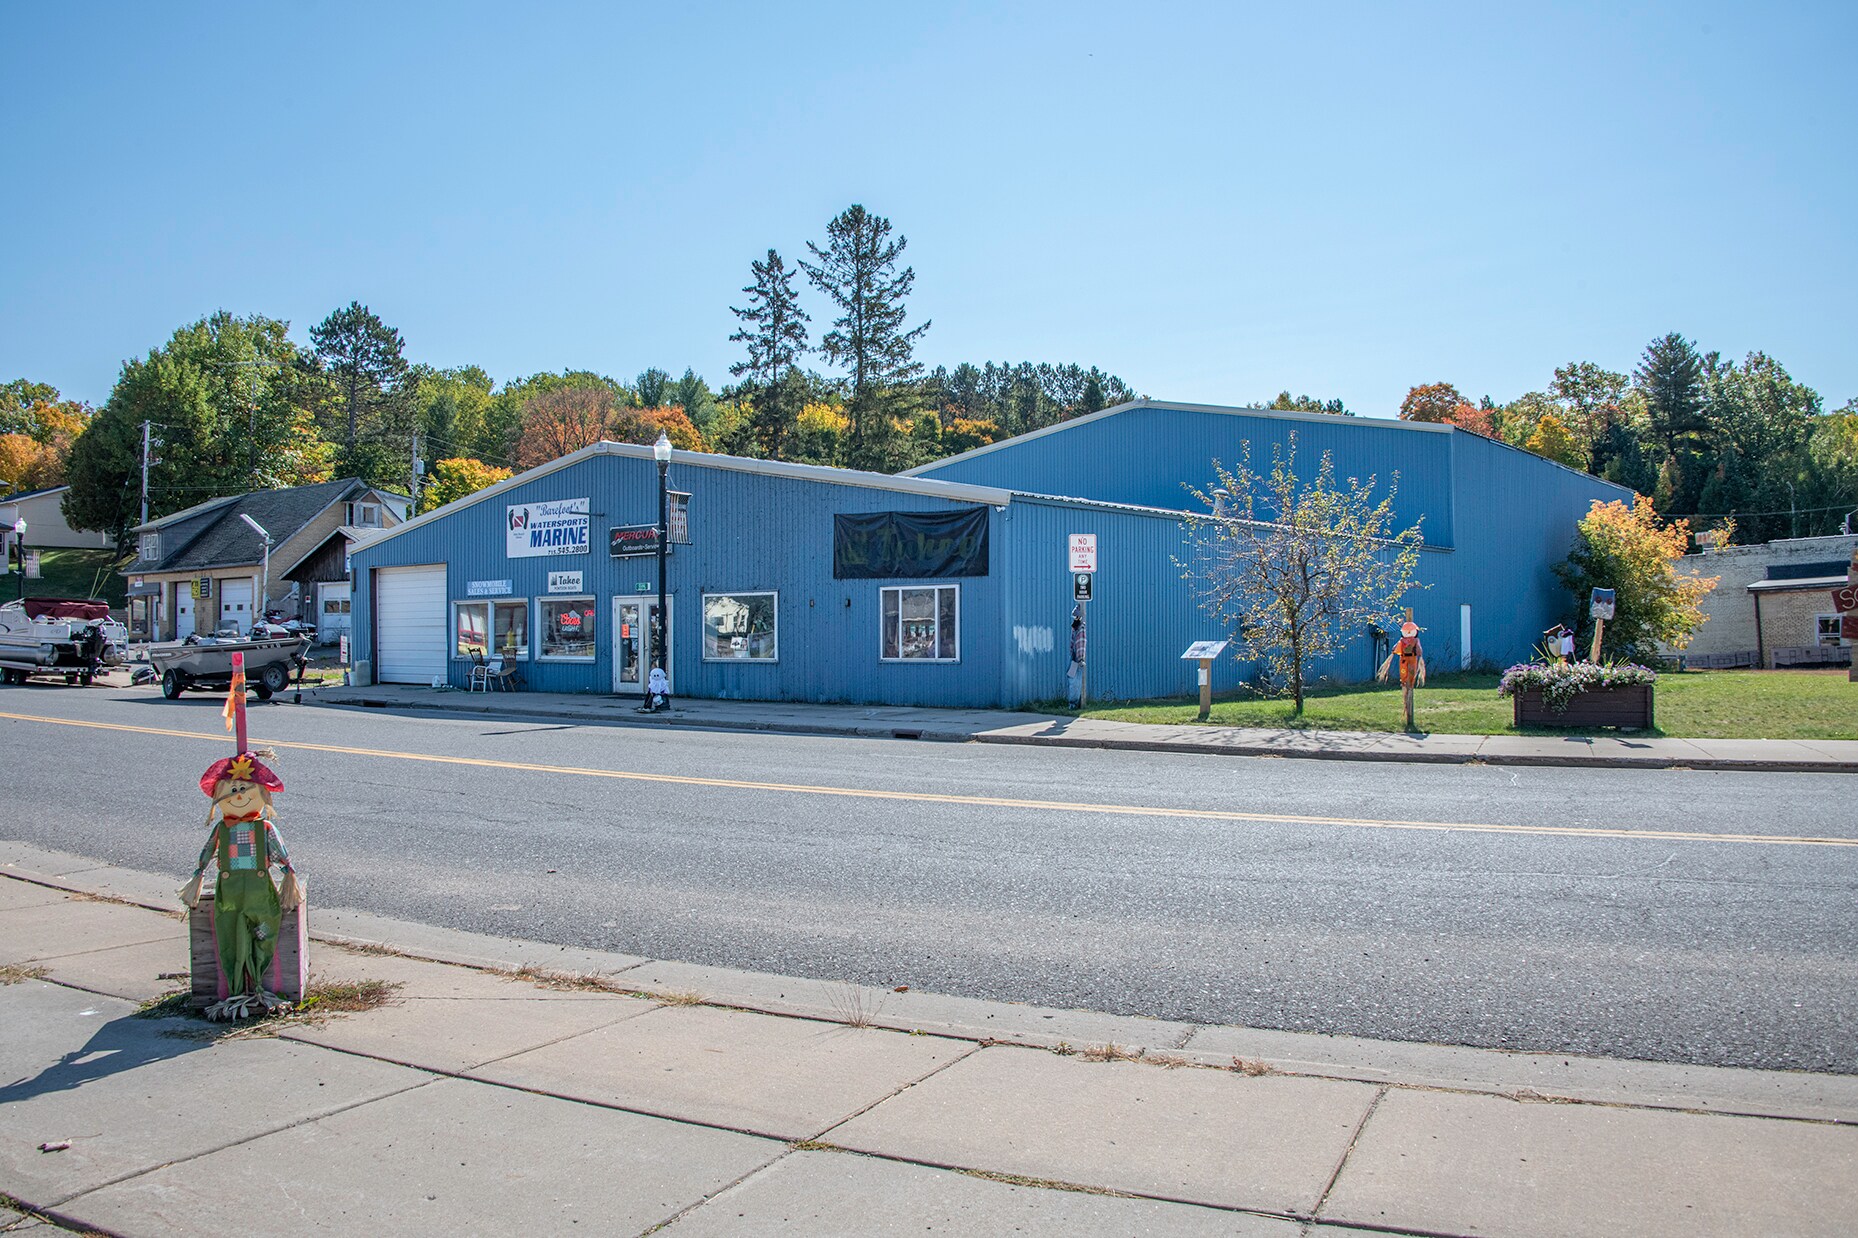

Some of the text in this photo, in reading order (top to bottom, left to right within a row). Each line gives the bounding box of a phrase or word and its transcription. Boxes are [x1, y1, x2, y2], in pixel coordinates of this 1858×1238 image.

[530, 518, 588, 529] WATERSPORTS
[530, 526, 588, 548] MARINE
[614, 529, 659, 541] MERCUR
[1078, 537, 1087, 545] NO
